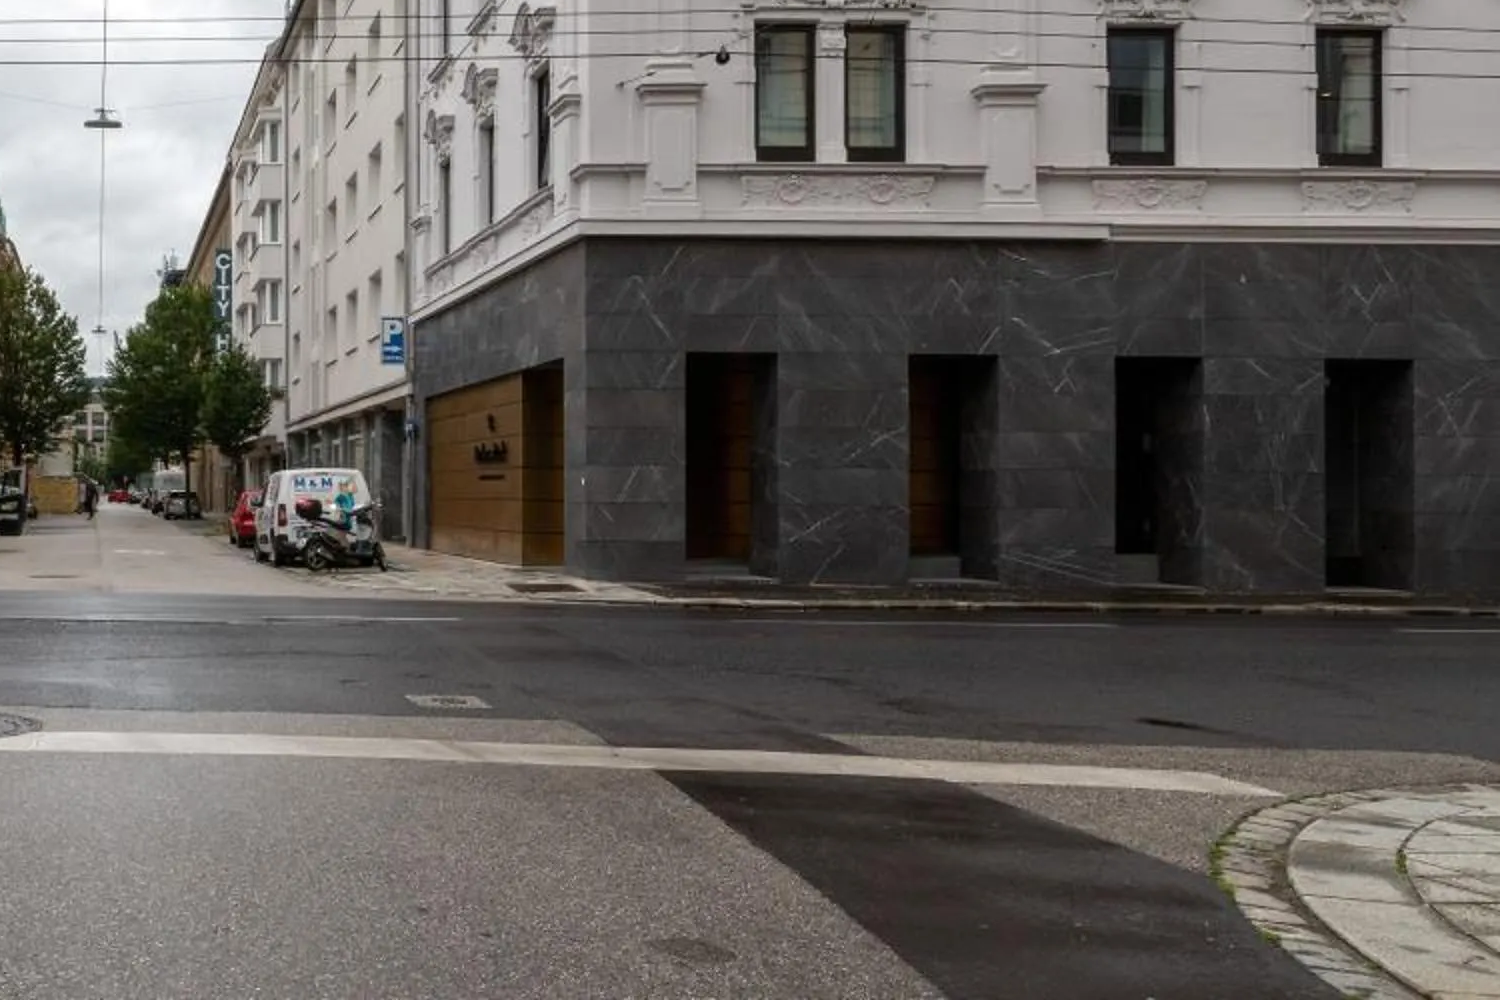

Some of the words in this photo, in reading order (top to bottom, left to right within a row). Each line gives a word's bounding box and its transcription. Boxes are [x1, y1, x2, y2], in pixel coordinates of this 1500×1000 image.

[216, 253, 231, 317] CITY
[383, 320, 403, 344] P
[294, 477, 306, 488] M
[321, 477, 333, 488] M
